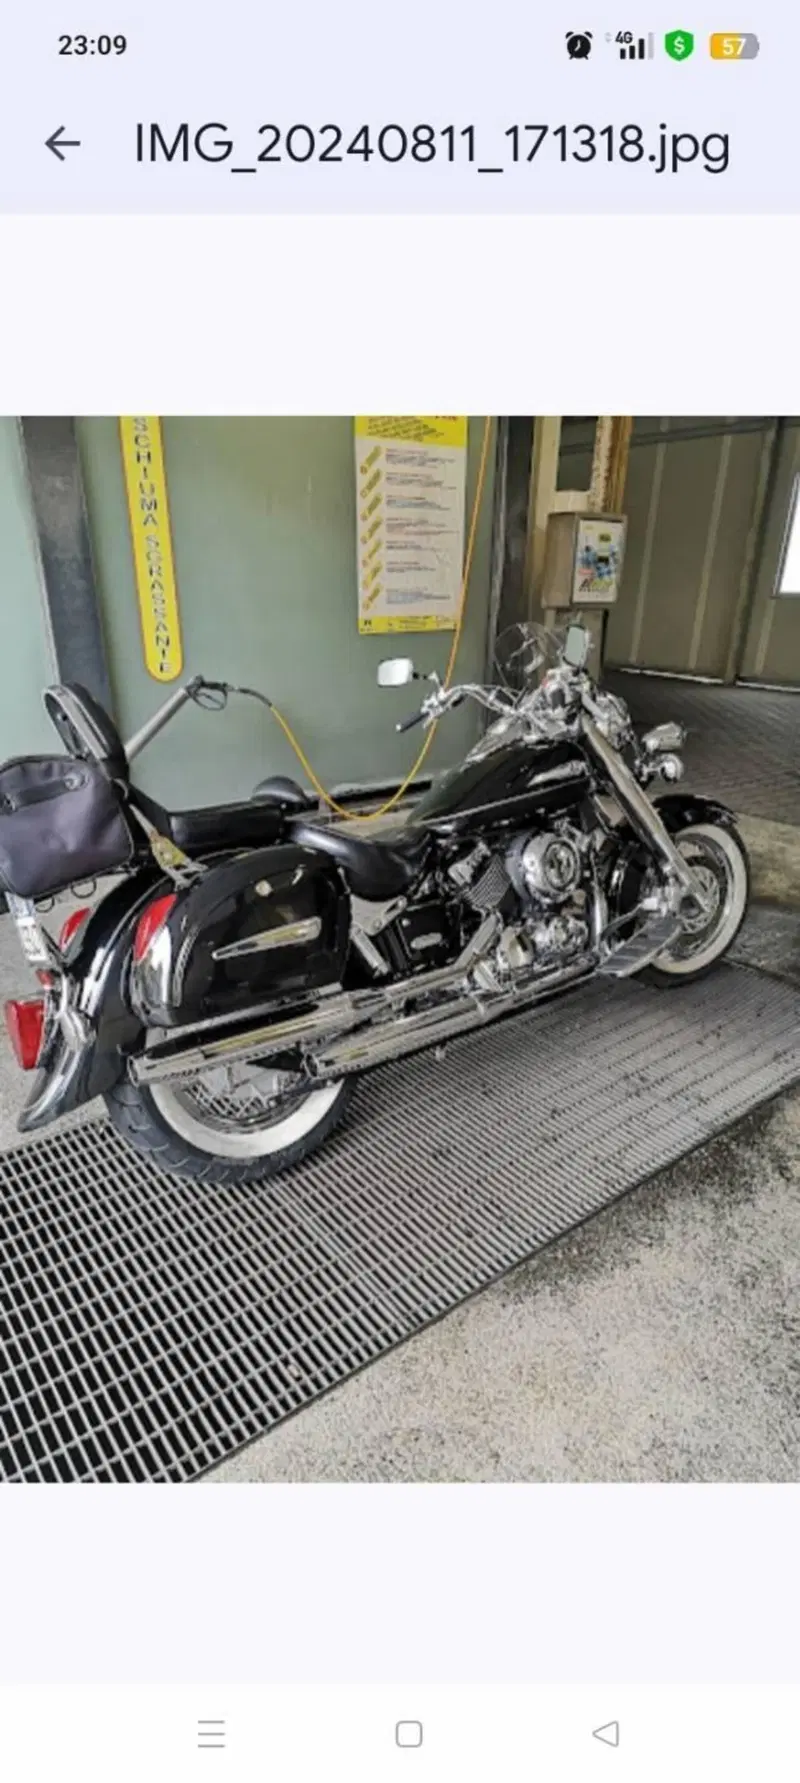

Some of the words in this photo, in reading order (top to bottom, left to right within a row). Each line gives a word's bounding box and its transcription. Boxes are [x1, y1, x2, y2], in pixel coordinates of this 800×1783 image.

[58, 35, 127, 56] 23:09
[615, 31, 634, 44] 4G
[722, 37, 747, 56] 57
[136, 122, 730, 173] IMG_20240811_171318.jpg
[134, 416, 158, 526] SCHIUMA
